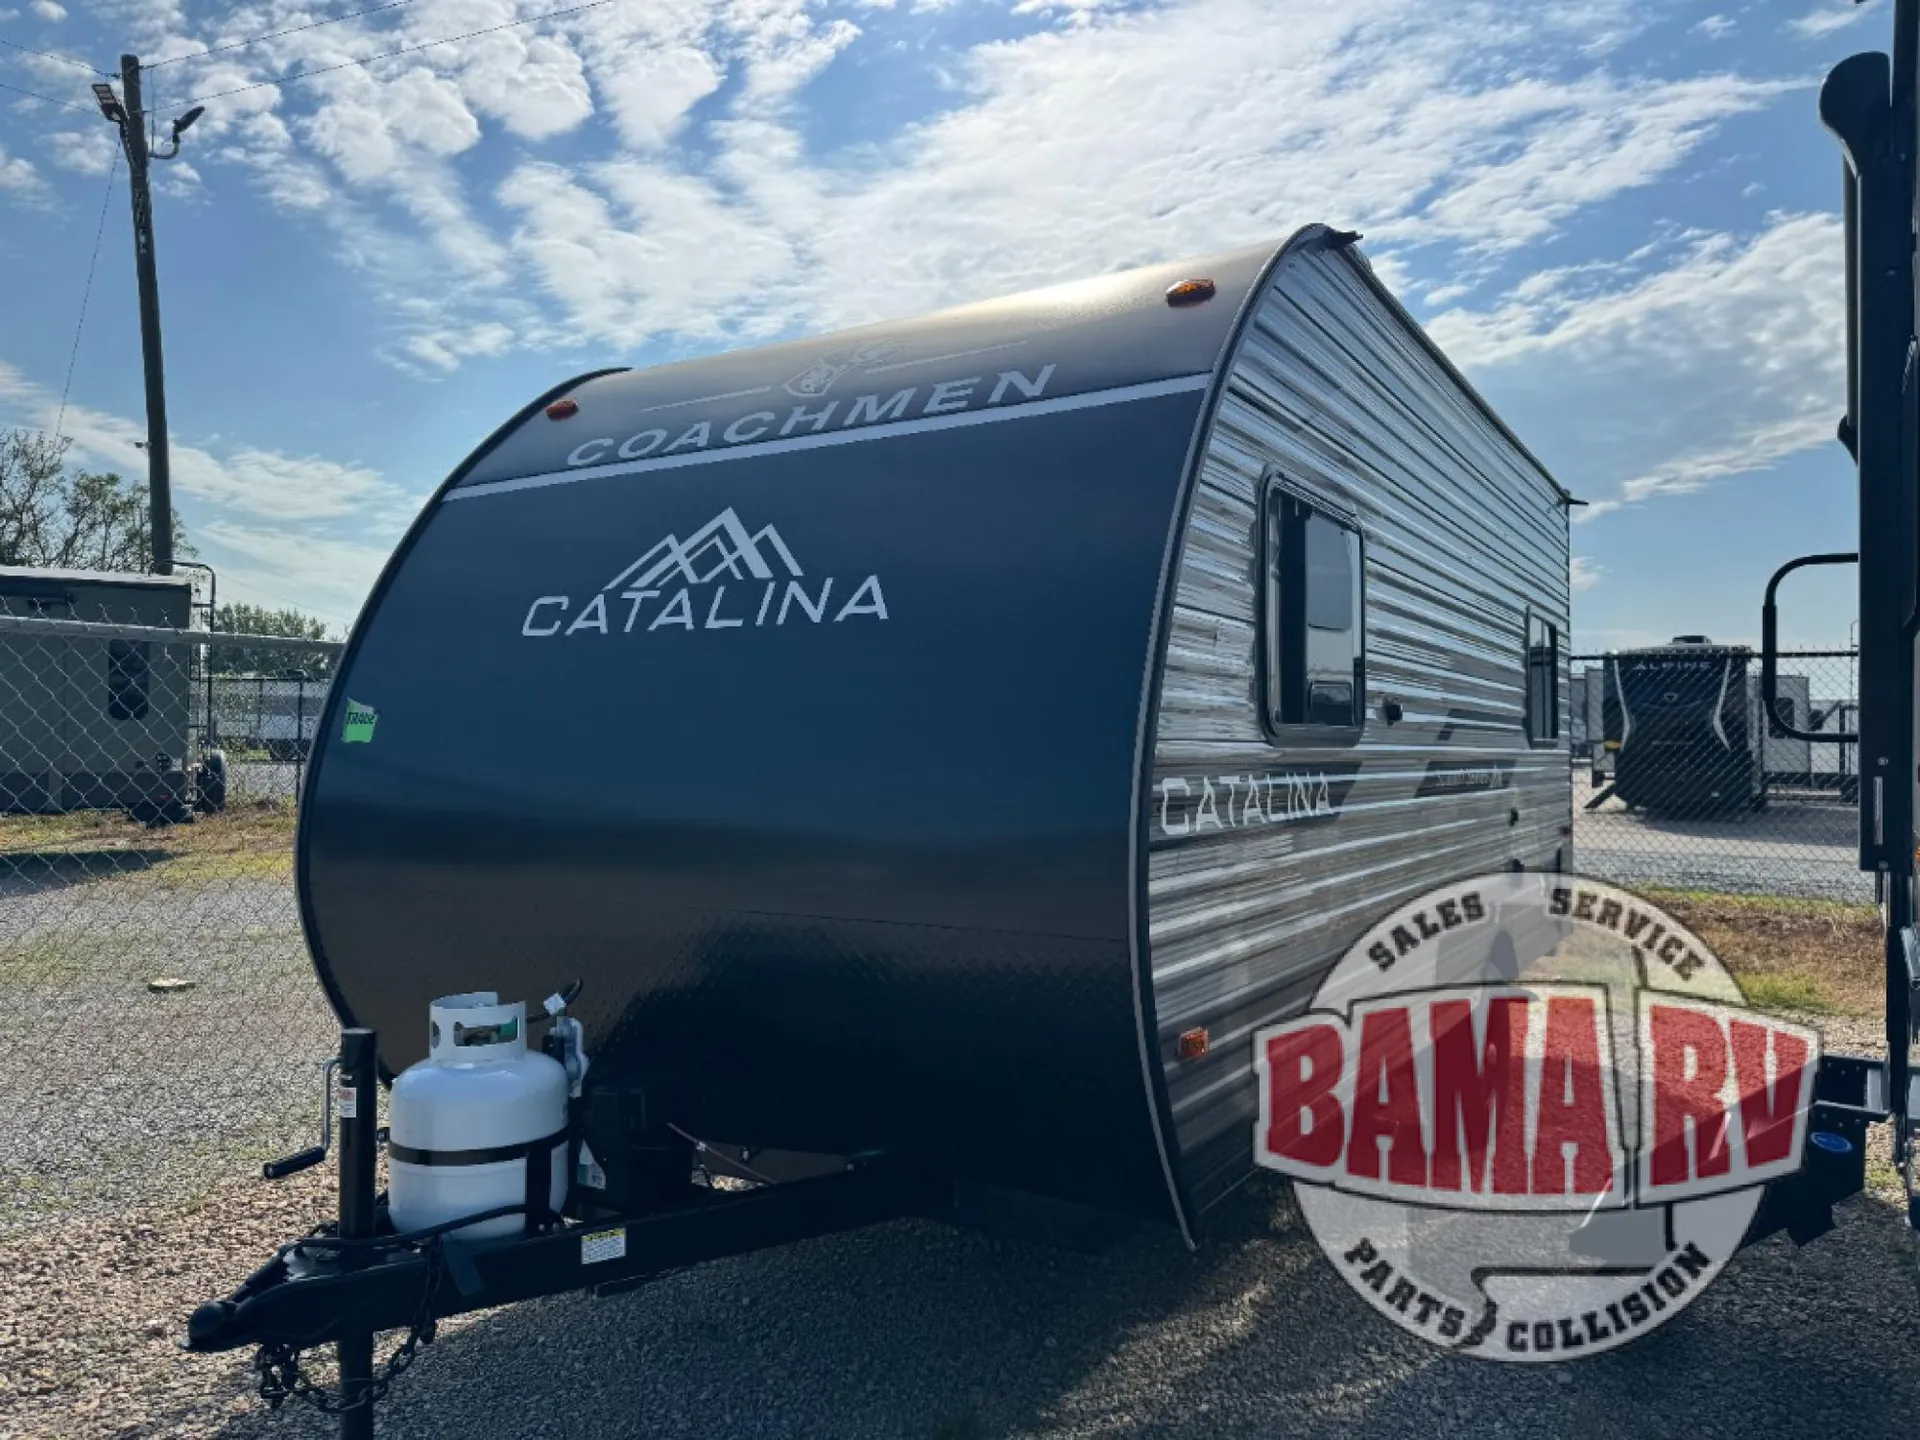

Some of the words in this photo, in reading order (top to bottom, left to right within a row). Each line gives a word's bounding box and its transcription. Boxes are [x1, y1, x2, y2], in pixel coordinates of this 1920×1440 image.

[567, 363, 1058, 467] COACHMEN
[522, 574, 890, 637] CATALINA
[1160, 770, 1335, 836] CATALINA
